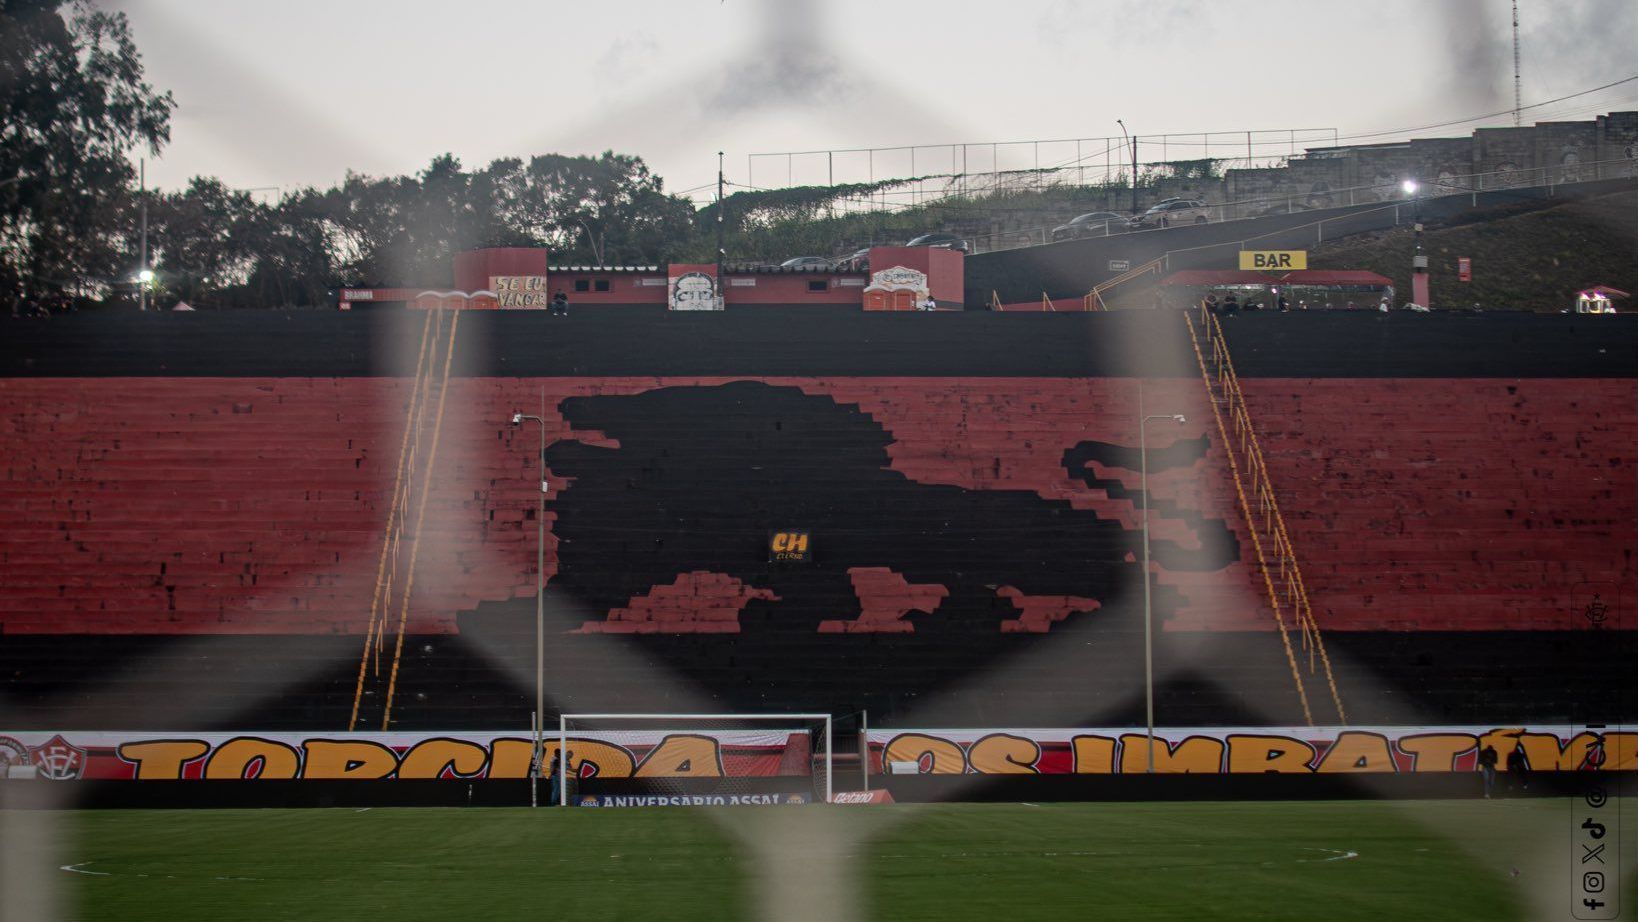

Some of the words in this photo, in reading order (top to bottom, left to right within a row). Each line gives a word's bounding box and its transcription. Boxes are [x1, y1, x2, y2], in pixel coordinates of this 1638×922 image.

[1254, 253, 1292, 268] BAR
[496, 278, 520, 290] SE
[772, 533, 808, 551] CH
